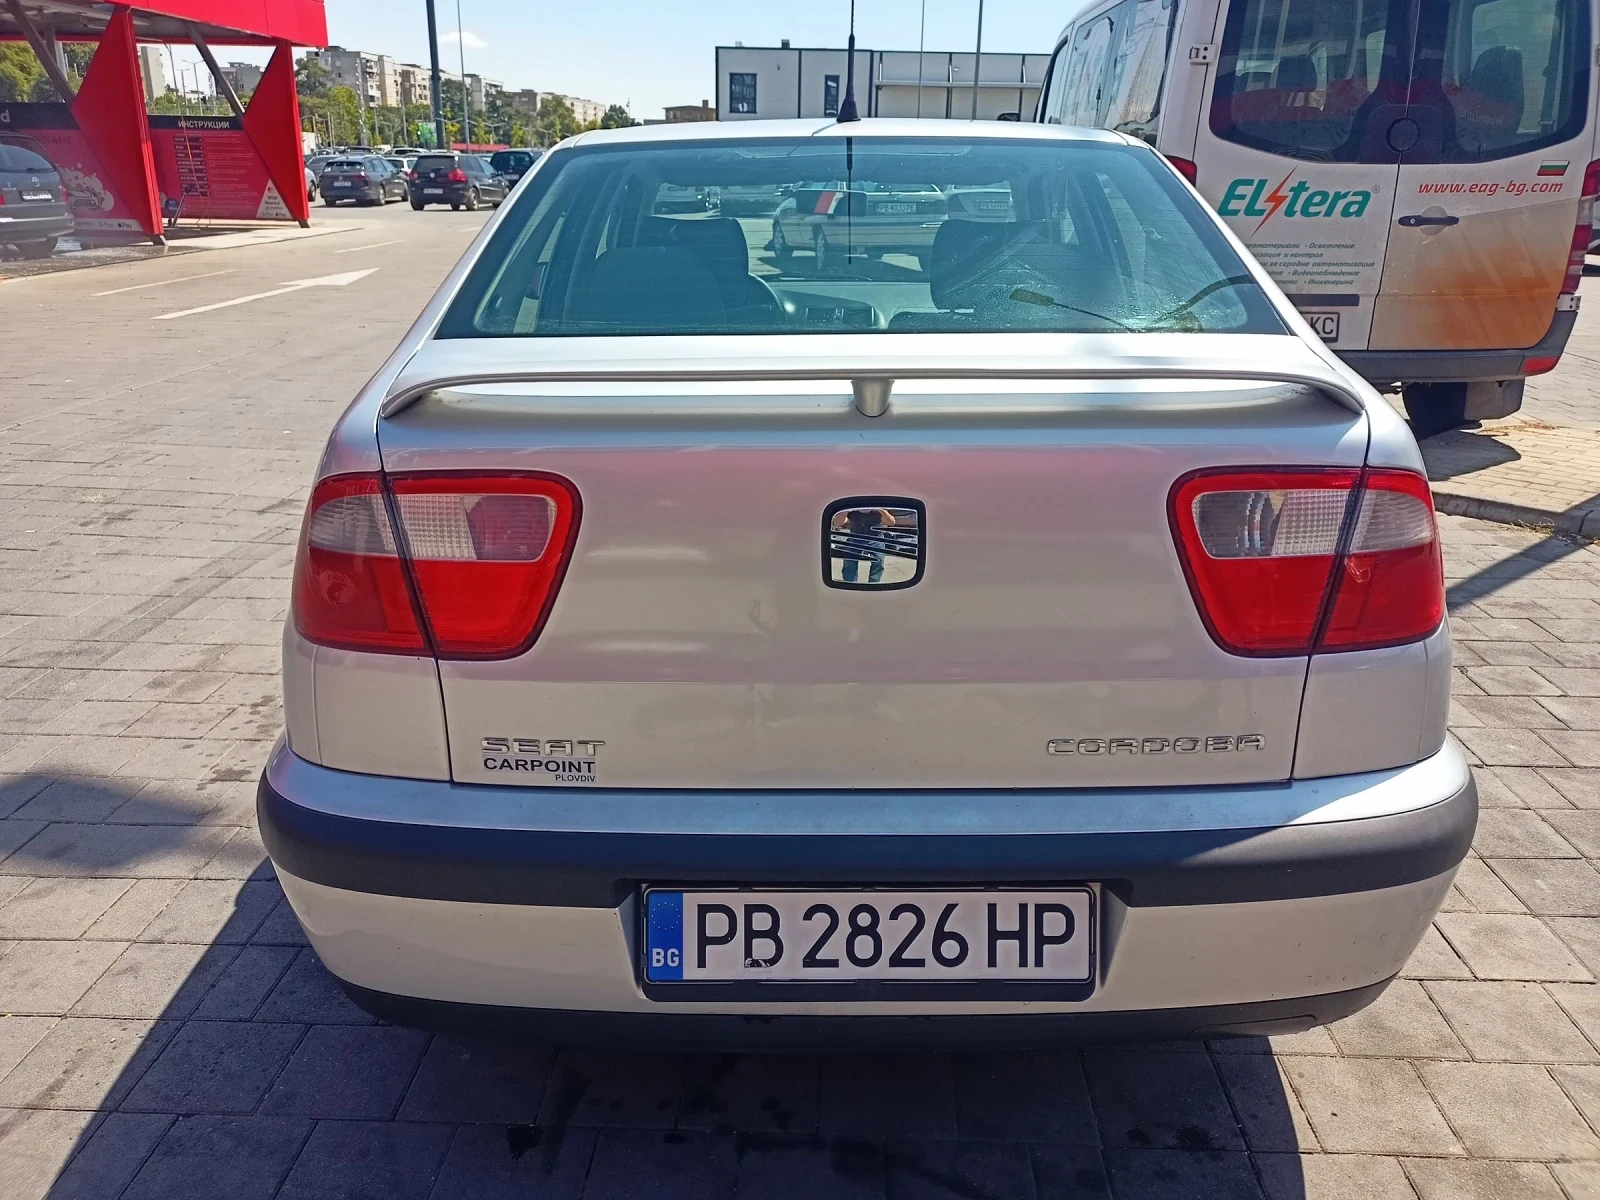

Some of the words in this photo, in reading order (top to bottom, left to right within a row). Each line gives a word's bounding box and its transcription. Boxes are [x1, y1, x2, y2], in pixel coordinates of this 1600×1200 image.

[177, 120, 230, 129] ИНСТРУКЦИИ
[1418, 180, 1563, 196] www.eag-bg.com
[1311, 260, 1375, 268] автоматизация
[1292, 269, 1360, 277] Видеонаблюдение
[481, 737, 606, 756] SEAT
[1046, 733, 1267, 756] CORDOBA
[483, 757, 596, 774] CARPOINT
[555, 774, 596, 783] PLOVDIV
[697, 903, 785, 969] PB
[802, 903, 969, 969] 2826
[986, 902, 1076, 969] HP
[652, 947, 680, 968] BG
